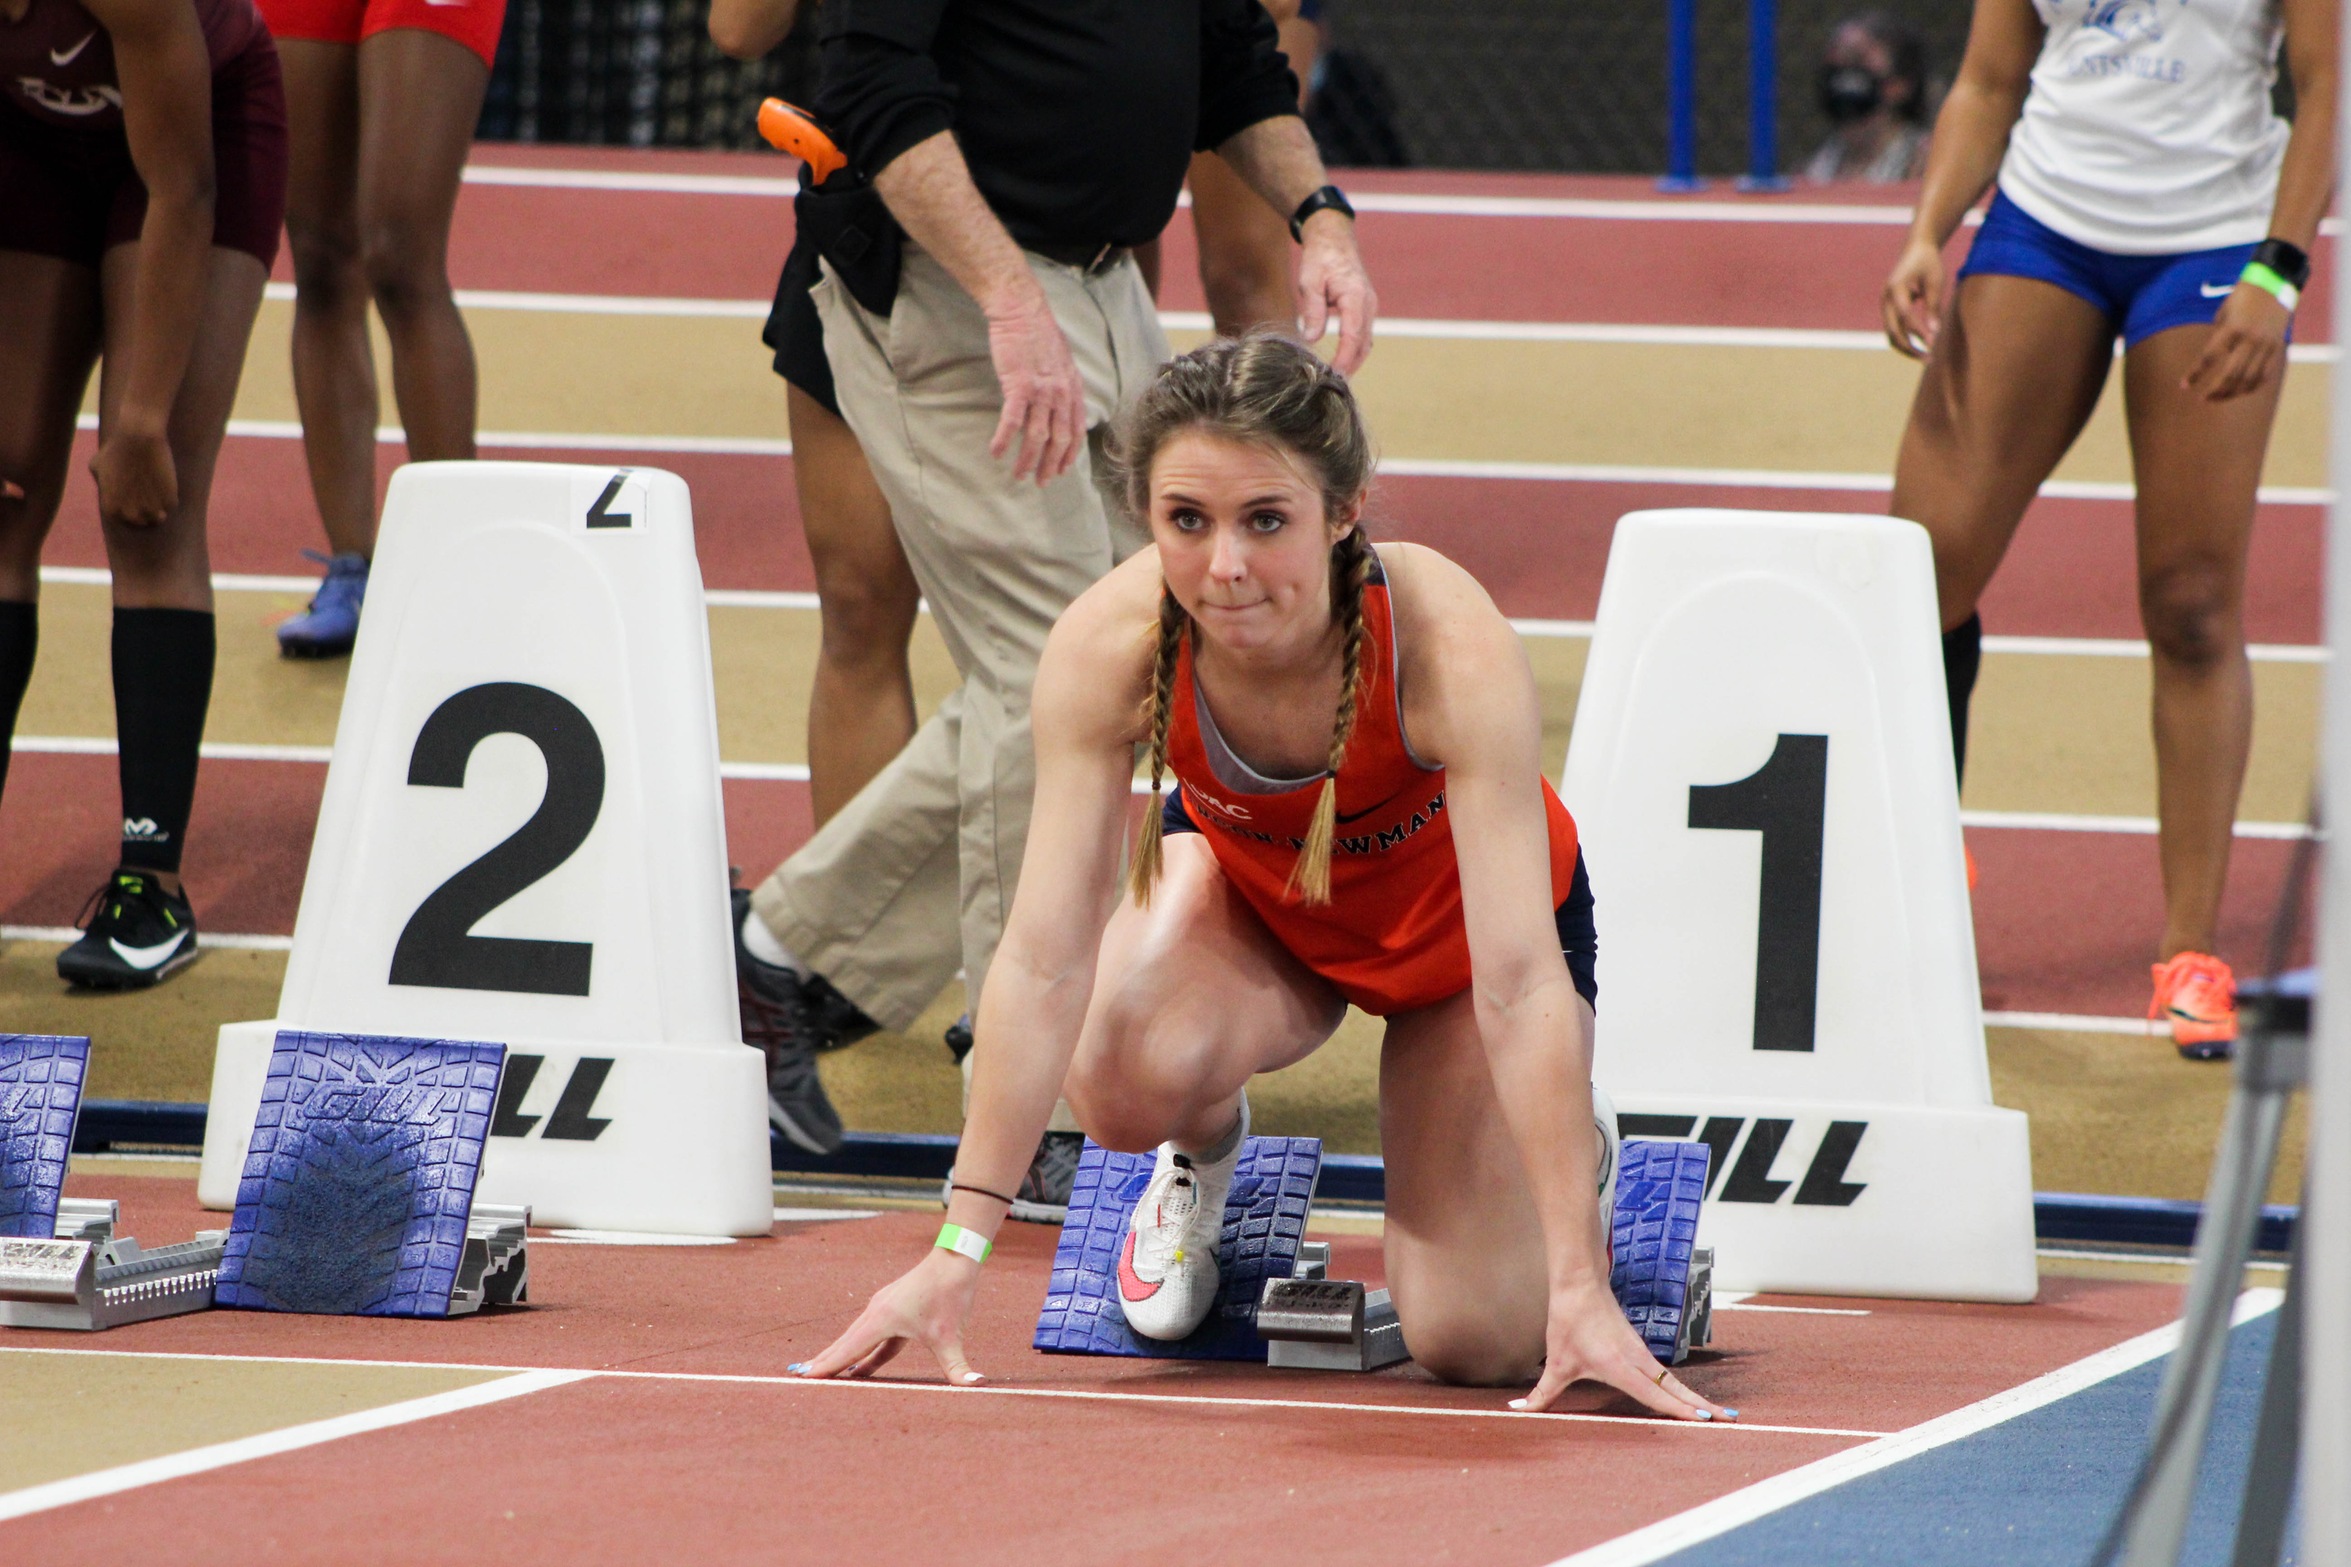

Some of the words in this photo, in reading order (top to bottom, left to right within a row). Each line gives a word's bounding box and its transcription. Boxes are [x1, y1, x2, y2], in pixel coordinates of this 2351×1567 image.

[388, 681, 606, 997] 2
[1286, 789, 1447, 855] NWMAN
[1688, 733, 1828, 1052] 1
[302, 1084, 446, 1126] GILL
[490, 1054, 615, 1141] LL
